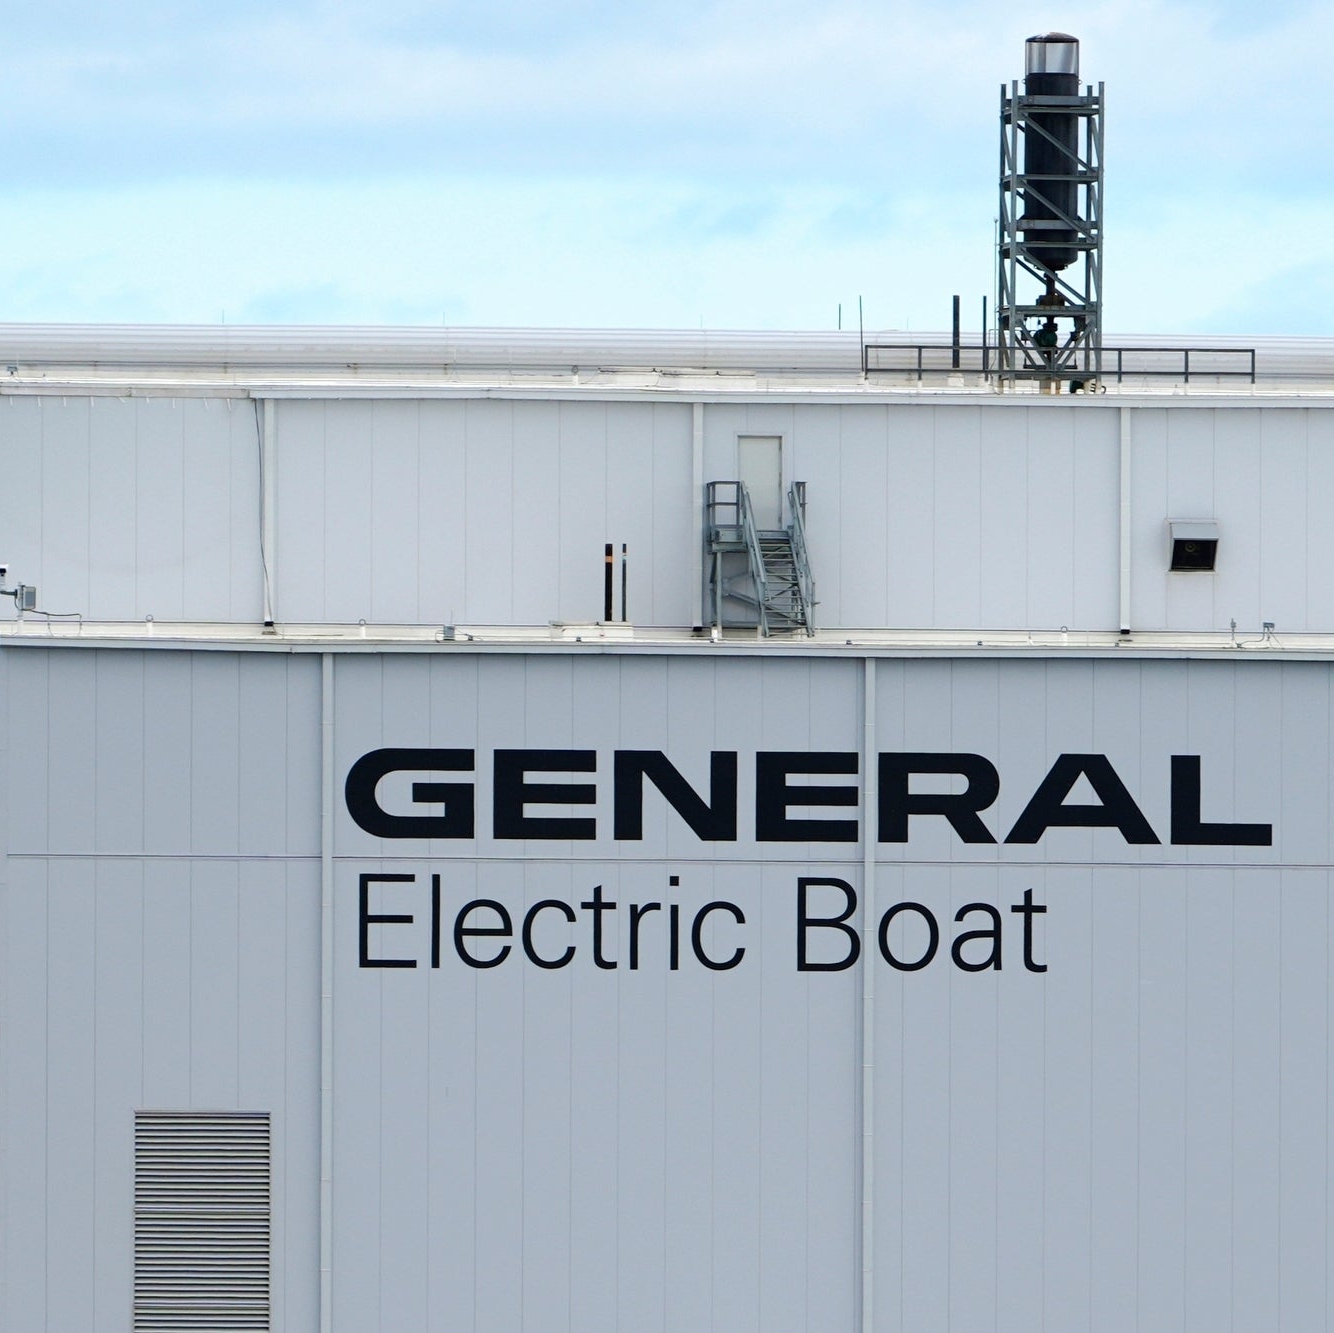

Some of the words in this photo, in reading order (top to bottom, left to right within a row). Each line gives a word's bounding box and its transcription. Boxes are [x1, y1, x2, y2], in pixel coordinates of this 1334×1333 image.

[345, 748, 1272, 846] GENERAL
[359, 874, 745, 970] Electric
[798, 878, 1047, 972] Boat
